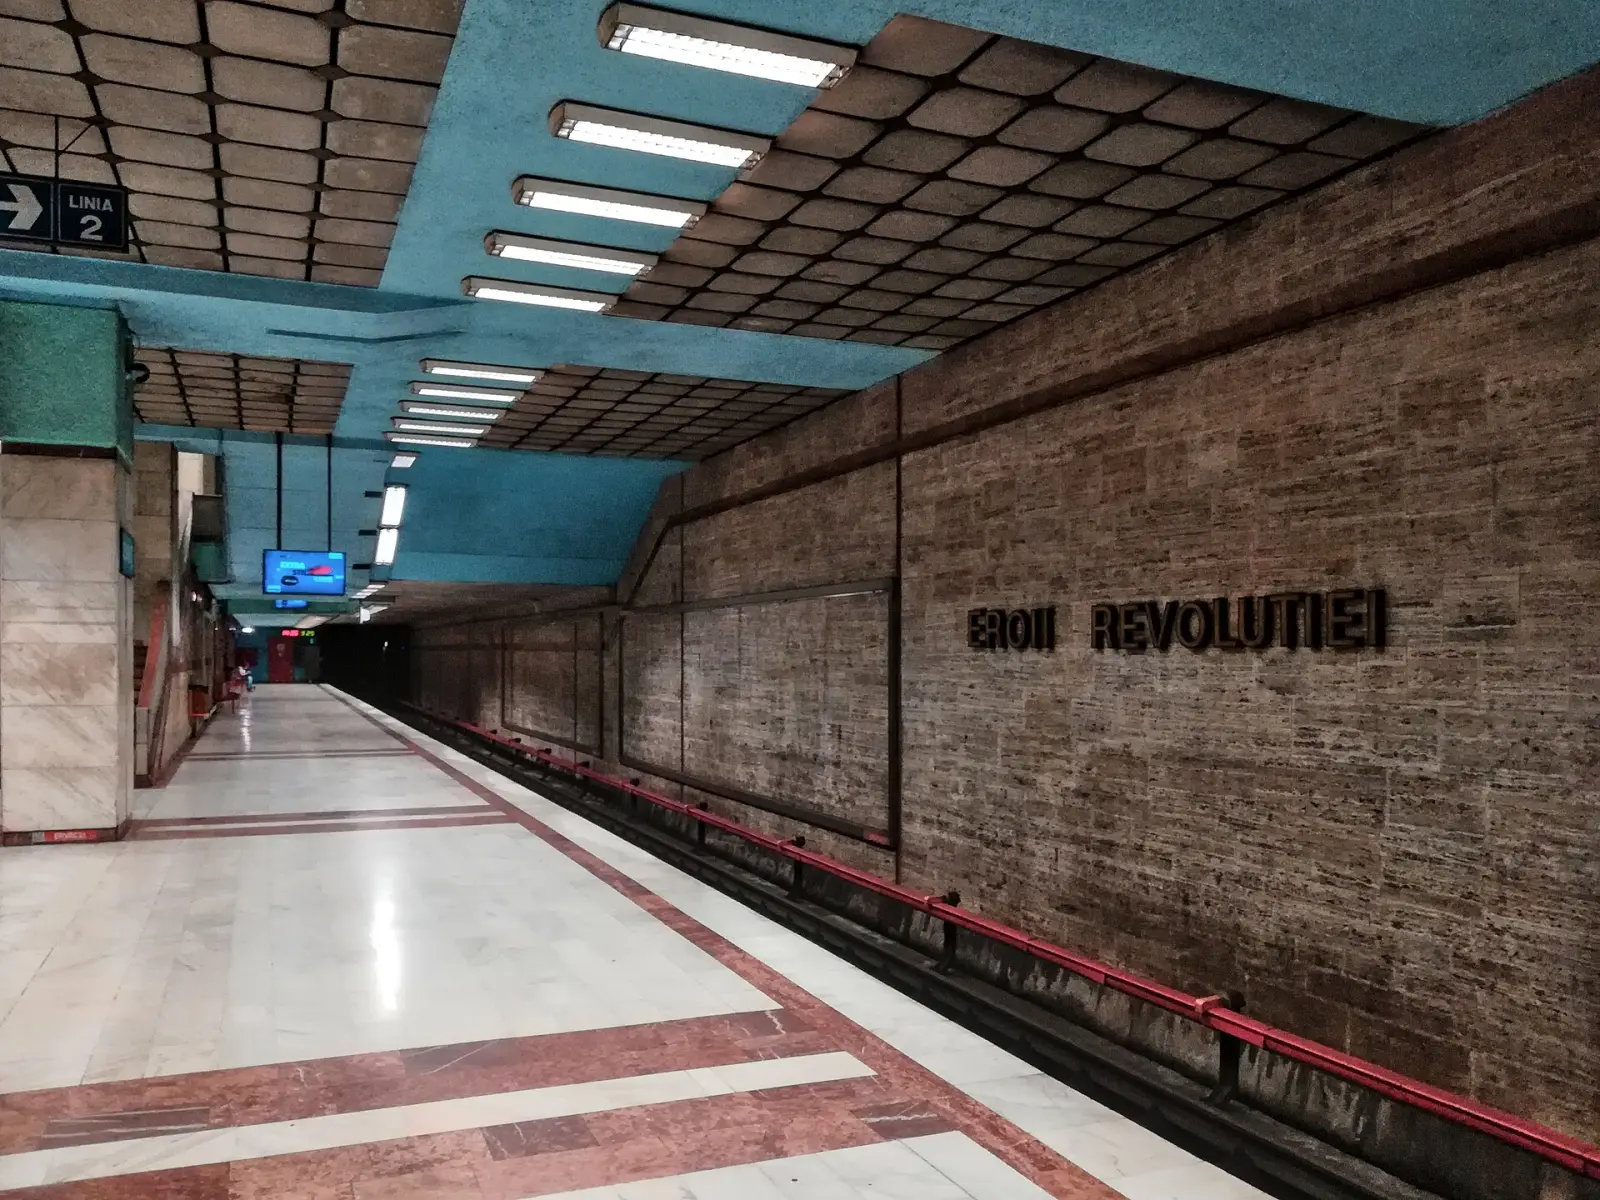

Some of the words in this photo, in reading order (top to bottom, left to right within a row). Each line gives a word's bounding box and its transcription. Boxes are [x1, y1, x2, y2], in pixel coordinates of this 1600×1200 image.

[69, 194, 114, 213] LINIA
[79, 214, 103, 241] 2
[967, 607, 1056, 650] EROII
[1090, 588, 1386, 652] REVOLUTIEI
